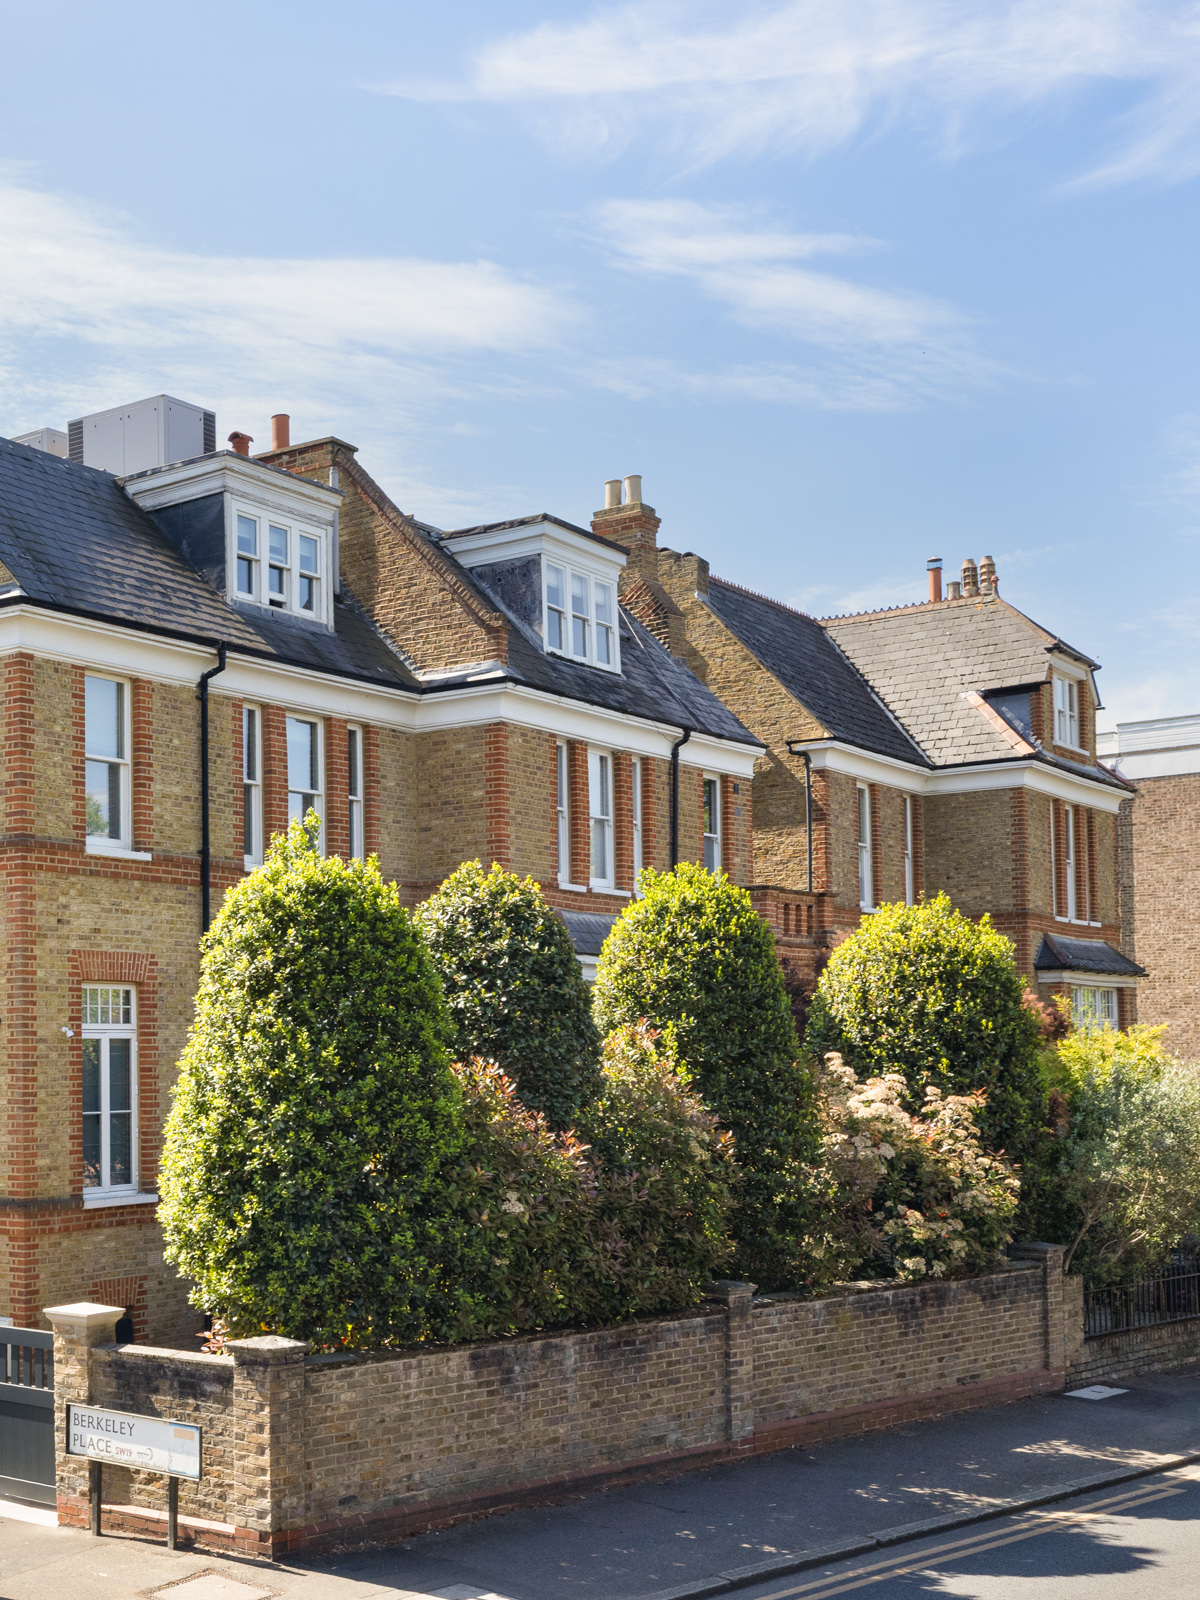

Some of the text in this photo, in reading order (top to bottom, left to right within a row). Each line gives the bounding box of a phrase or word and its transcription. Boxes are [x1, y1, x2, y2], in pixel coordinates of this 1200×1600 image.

[73, 1412, 135, 1437] BERKELEY
[73, 1433, 133, 1457] PLACE SW19
